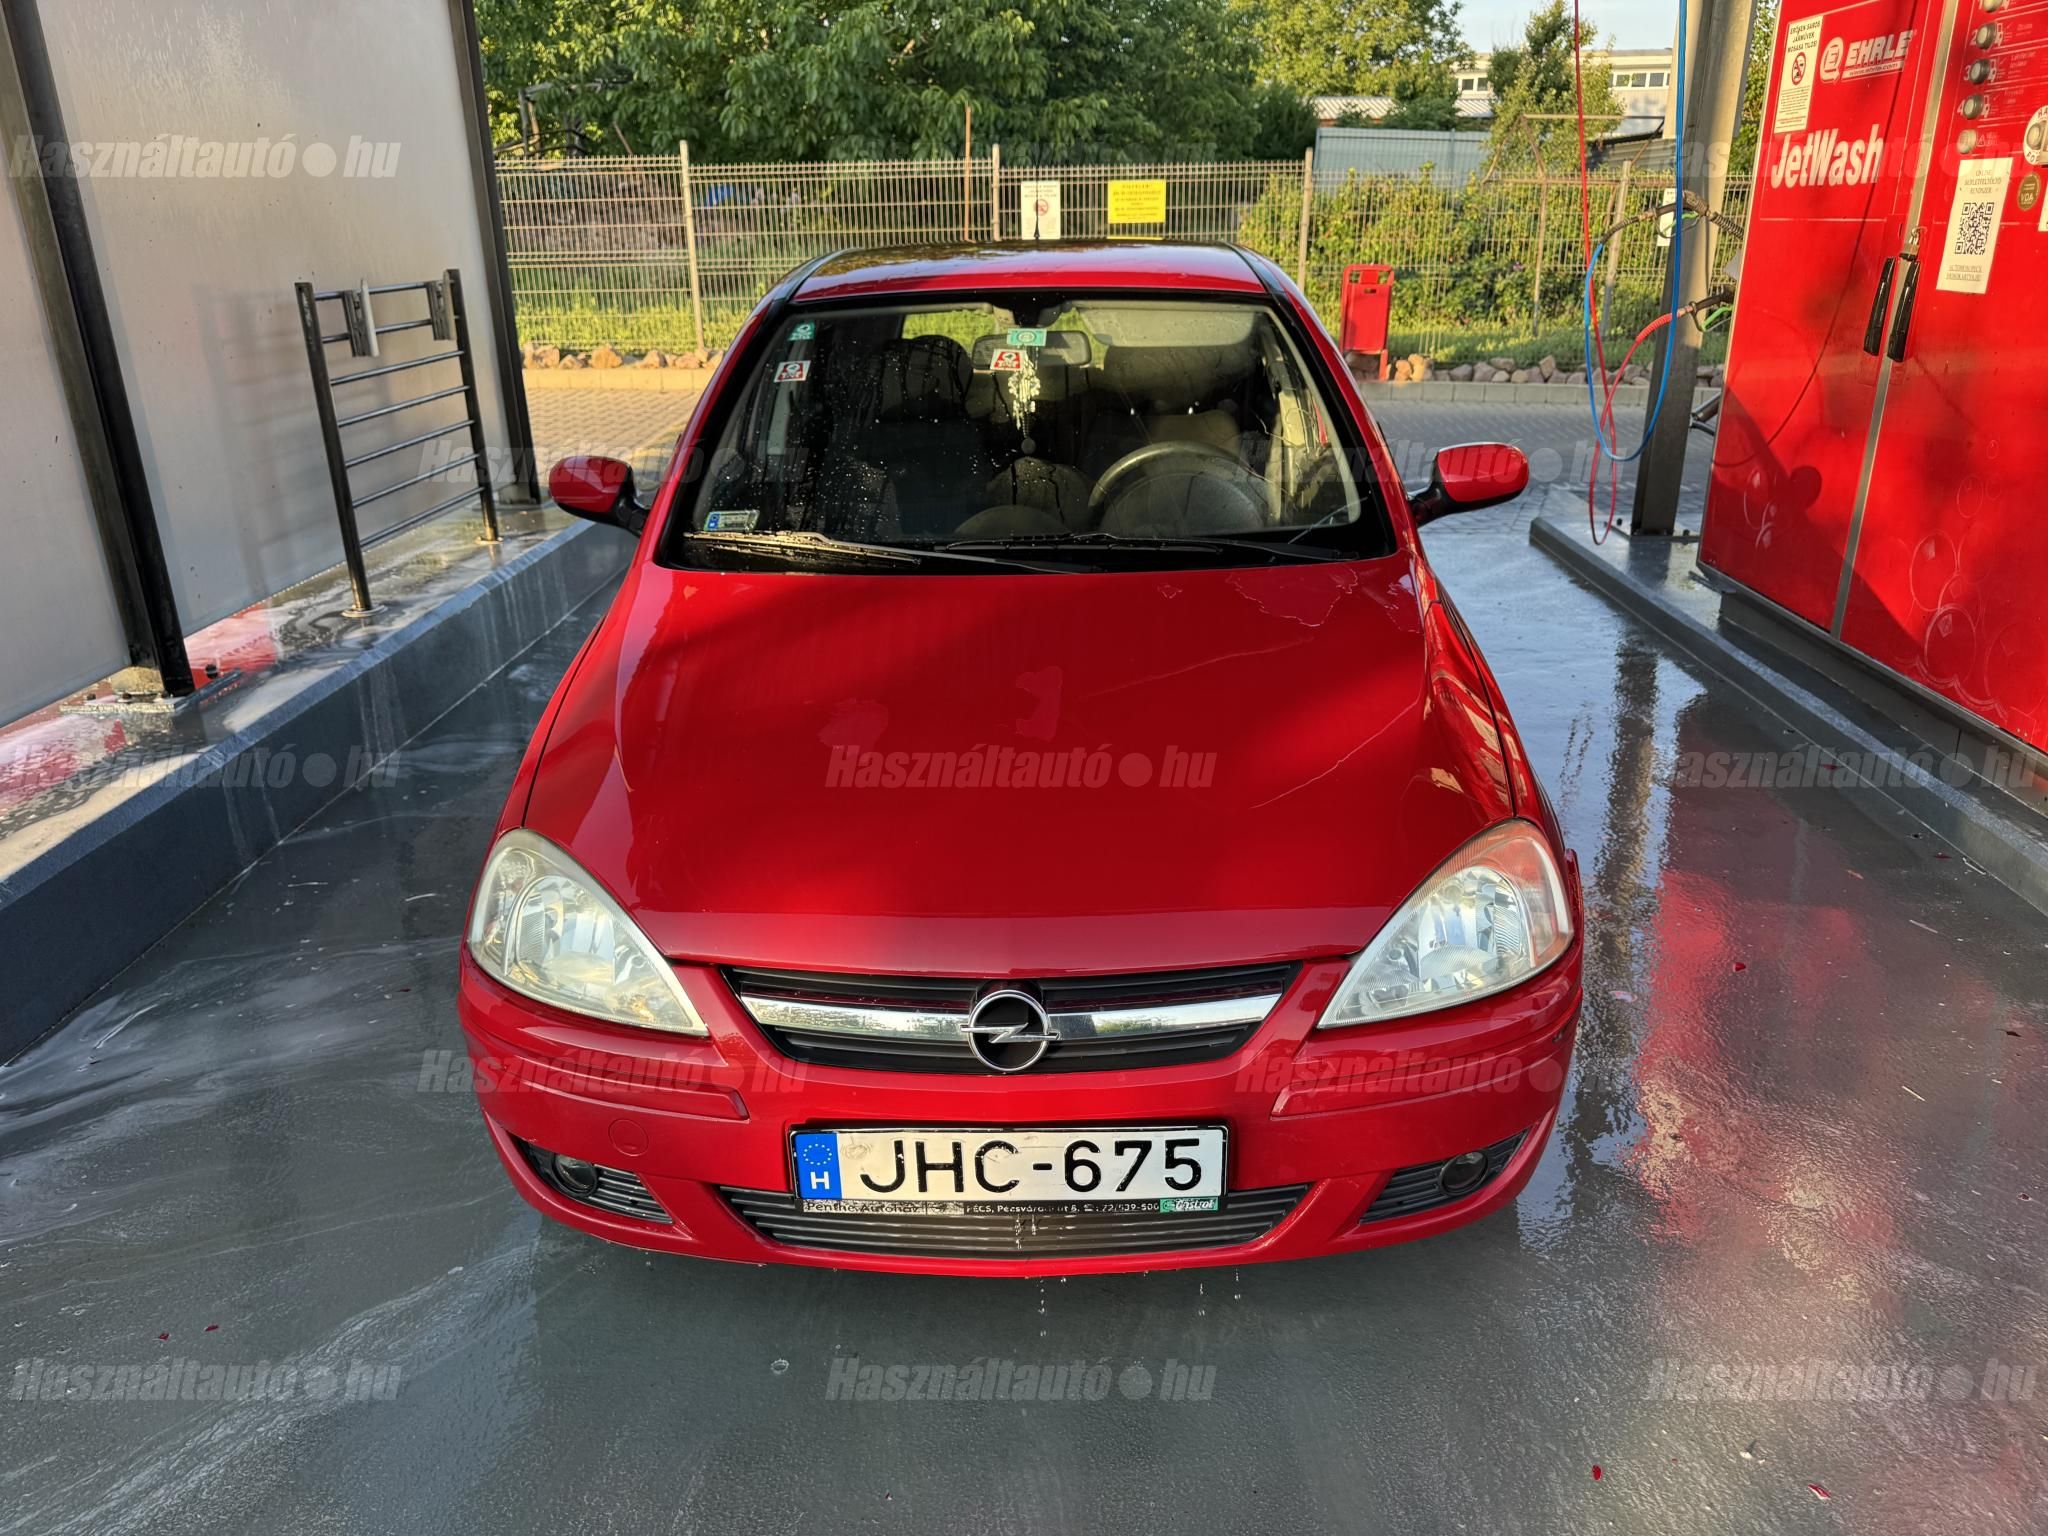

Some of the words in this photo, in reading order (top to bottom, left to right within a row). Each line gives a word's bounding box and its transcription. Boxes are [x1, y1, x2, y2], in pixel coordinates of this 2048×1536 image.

[1845, 29, 1913, 68] EHRLE
[1770, 123, 1888, 189] JetWash
[810, 1172, 831, 1190] H
[859, 1138, 1203, 1194] JHC-675
[1174, 1198, 1215, 1212] Castrol
